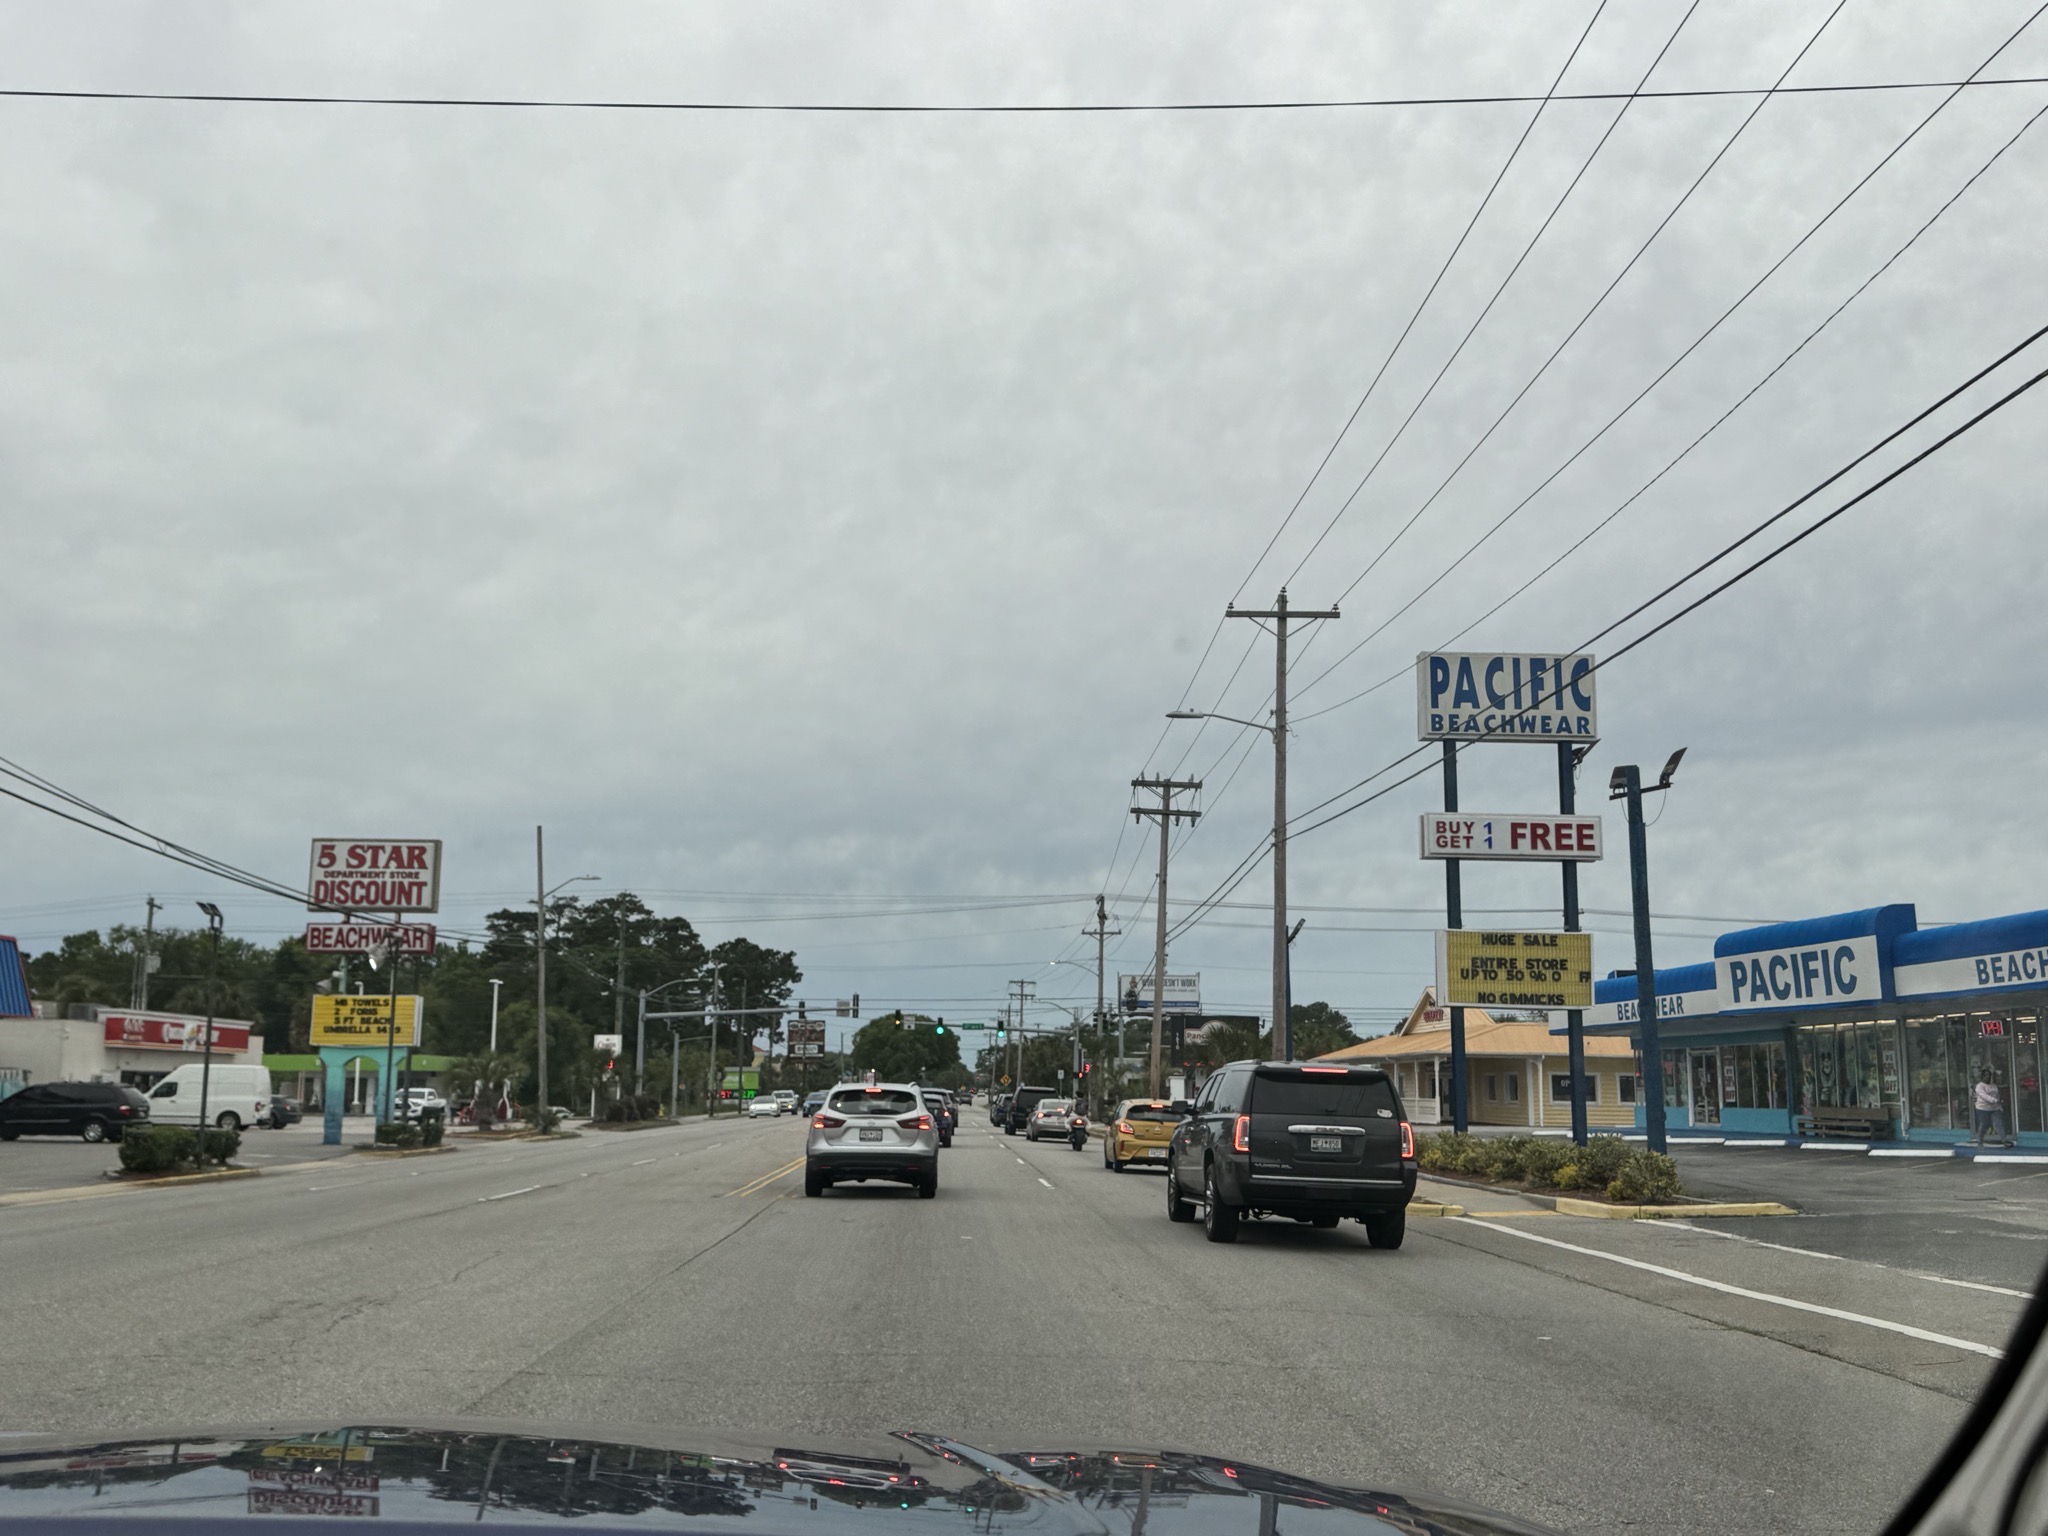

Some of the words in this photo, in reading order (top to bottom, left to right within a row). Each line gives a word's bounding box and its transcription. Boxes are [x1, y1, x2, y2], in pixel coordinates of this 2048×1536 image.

[1429, 656, 1591, 712] PACIFIC
[1430, 713, 1591, 735] BEACHWEAR
[1436, 820, 1475, 834] BUY
[1483, 822, 1492, 835] 1
[1436, 835, 1474, 849] GET
[1483, 836, 1493, 849] 1
[1510, 822, 1596, 852] FREE
[317, 844, 336, 869] 5
[345, 844, 428, 870] STAR
[323, 870, 386, 879] DEPARTMENT
[389, 871, 420, 880] STORE
[314, 880, 427, 906] DISCOUNT
[309, 926, 424, 949] BEACHWAR
[1481, 933, 1515, 946] HUGE
[1523, 935, 1558, 947] SALE
[1471, 957, 1518, 969] ENTIRE
[1526, 958, 1568, 970] STORE
[1730, 946, 1857, 1004] PACIFIC
[352, 998, 390, 1007] TOWELS
[1478, 991, 1496, 1004] NO
[1500, 992, 1565, 1006] GIMMICKS
[323, 1025, 371, 1034] UMBRELLA
